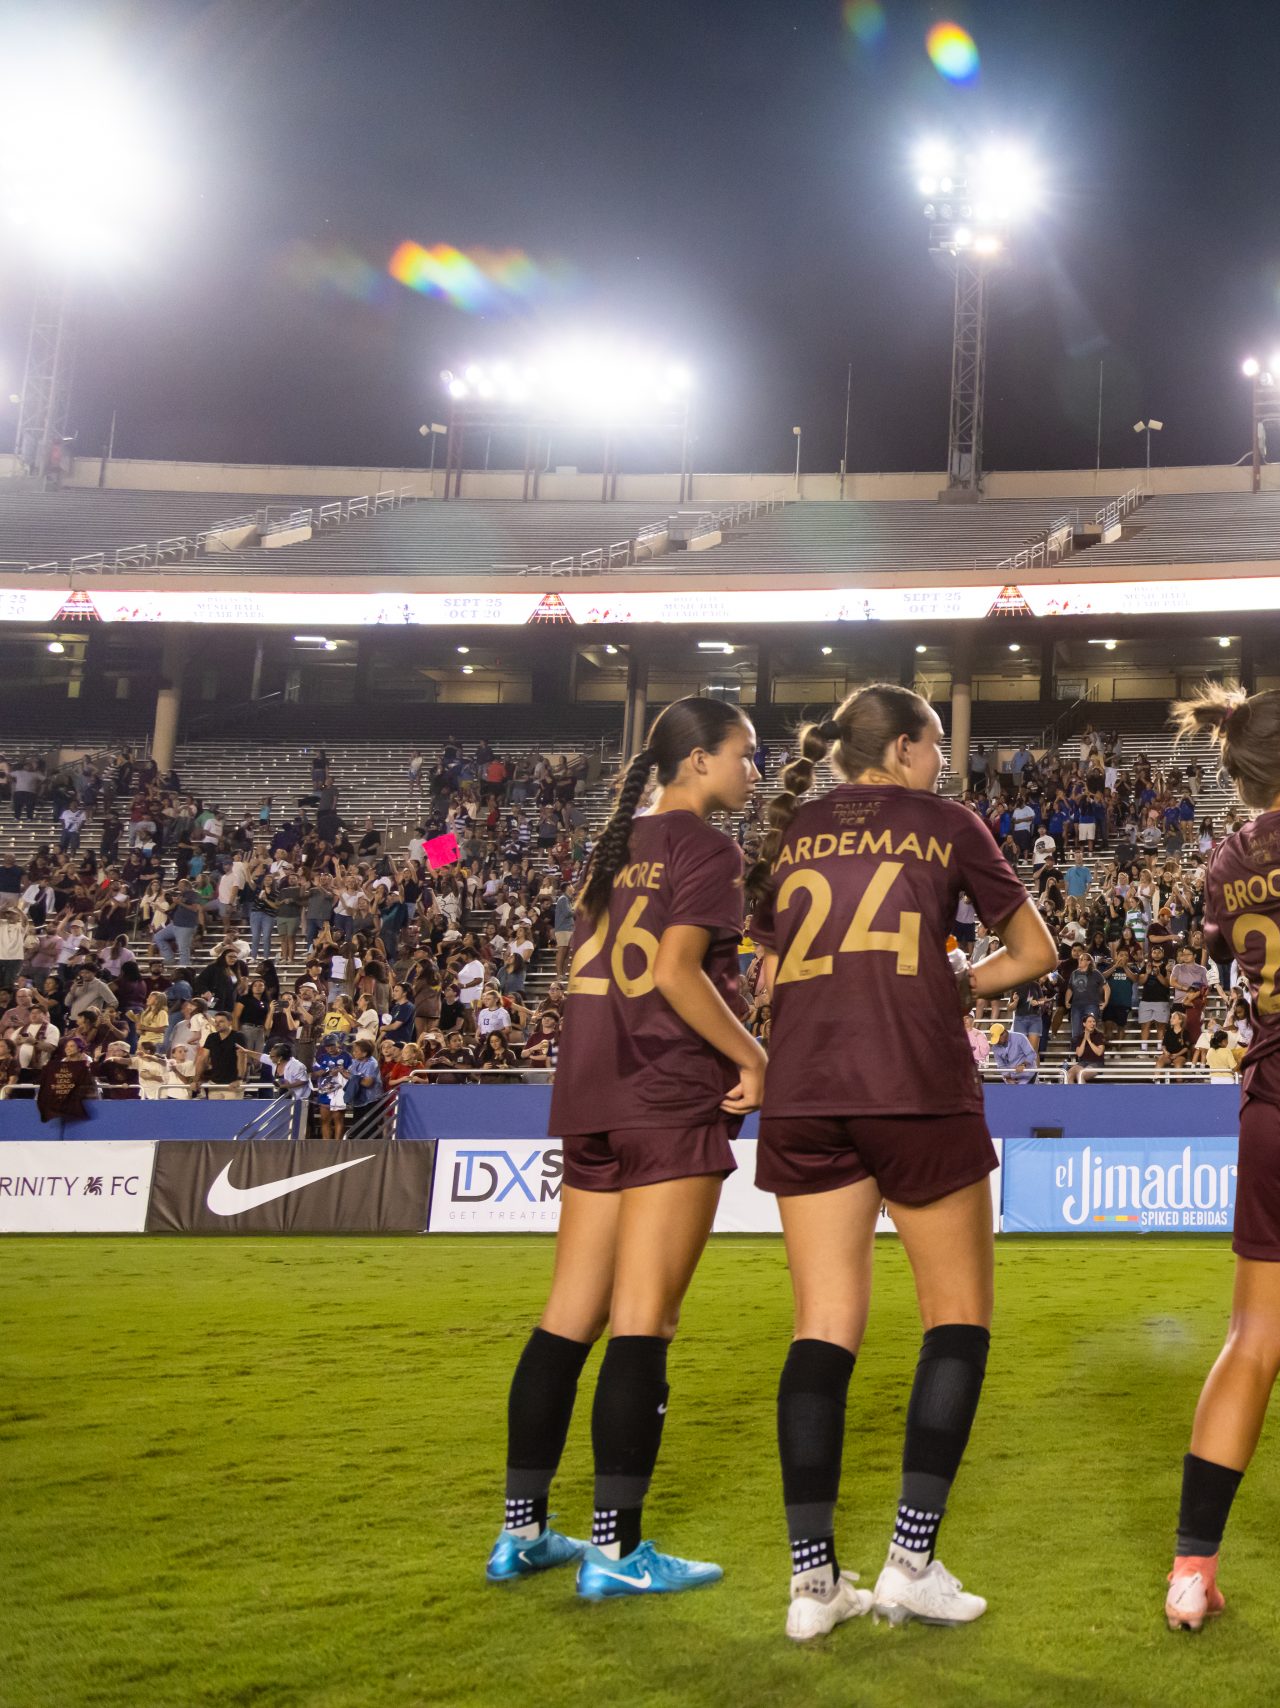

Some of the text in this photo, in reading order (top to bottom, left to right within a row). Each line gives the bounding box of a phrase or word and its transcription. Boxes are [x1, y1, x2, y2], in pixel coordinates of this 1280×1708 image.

[443, 598, 503, 608] SEPT 25
[903, 592, 961, 602] SEPT 25
[832, 809, 880, 818] TRINITY
[834, 801, 881, 812] DALLAS
[770, 829, 953, 876] ARDEMAN
[776, 861, 920, 985] 24
[567, 895, 661, 998] 26
[0, 1175, 140, 1197] RINITY FC
[1055, 1145, 1238, 1225] el Jimador
[449, 1211, 559, 1220] GET TREATED
[1141, 1210, 1228, 1226] SPIKED BEBIDAS
